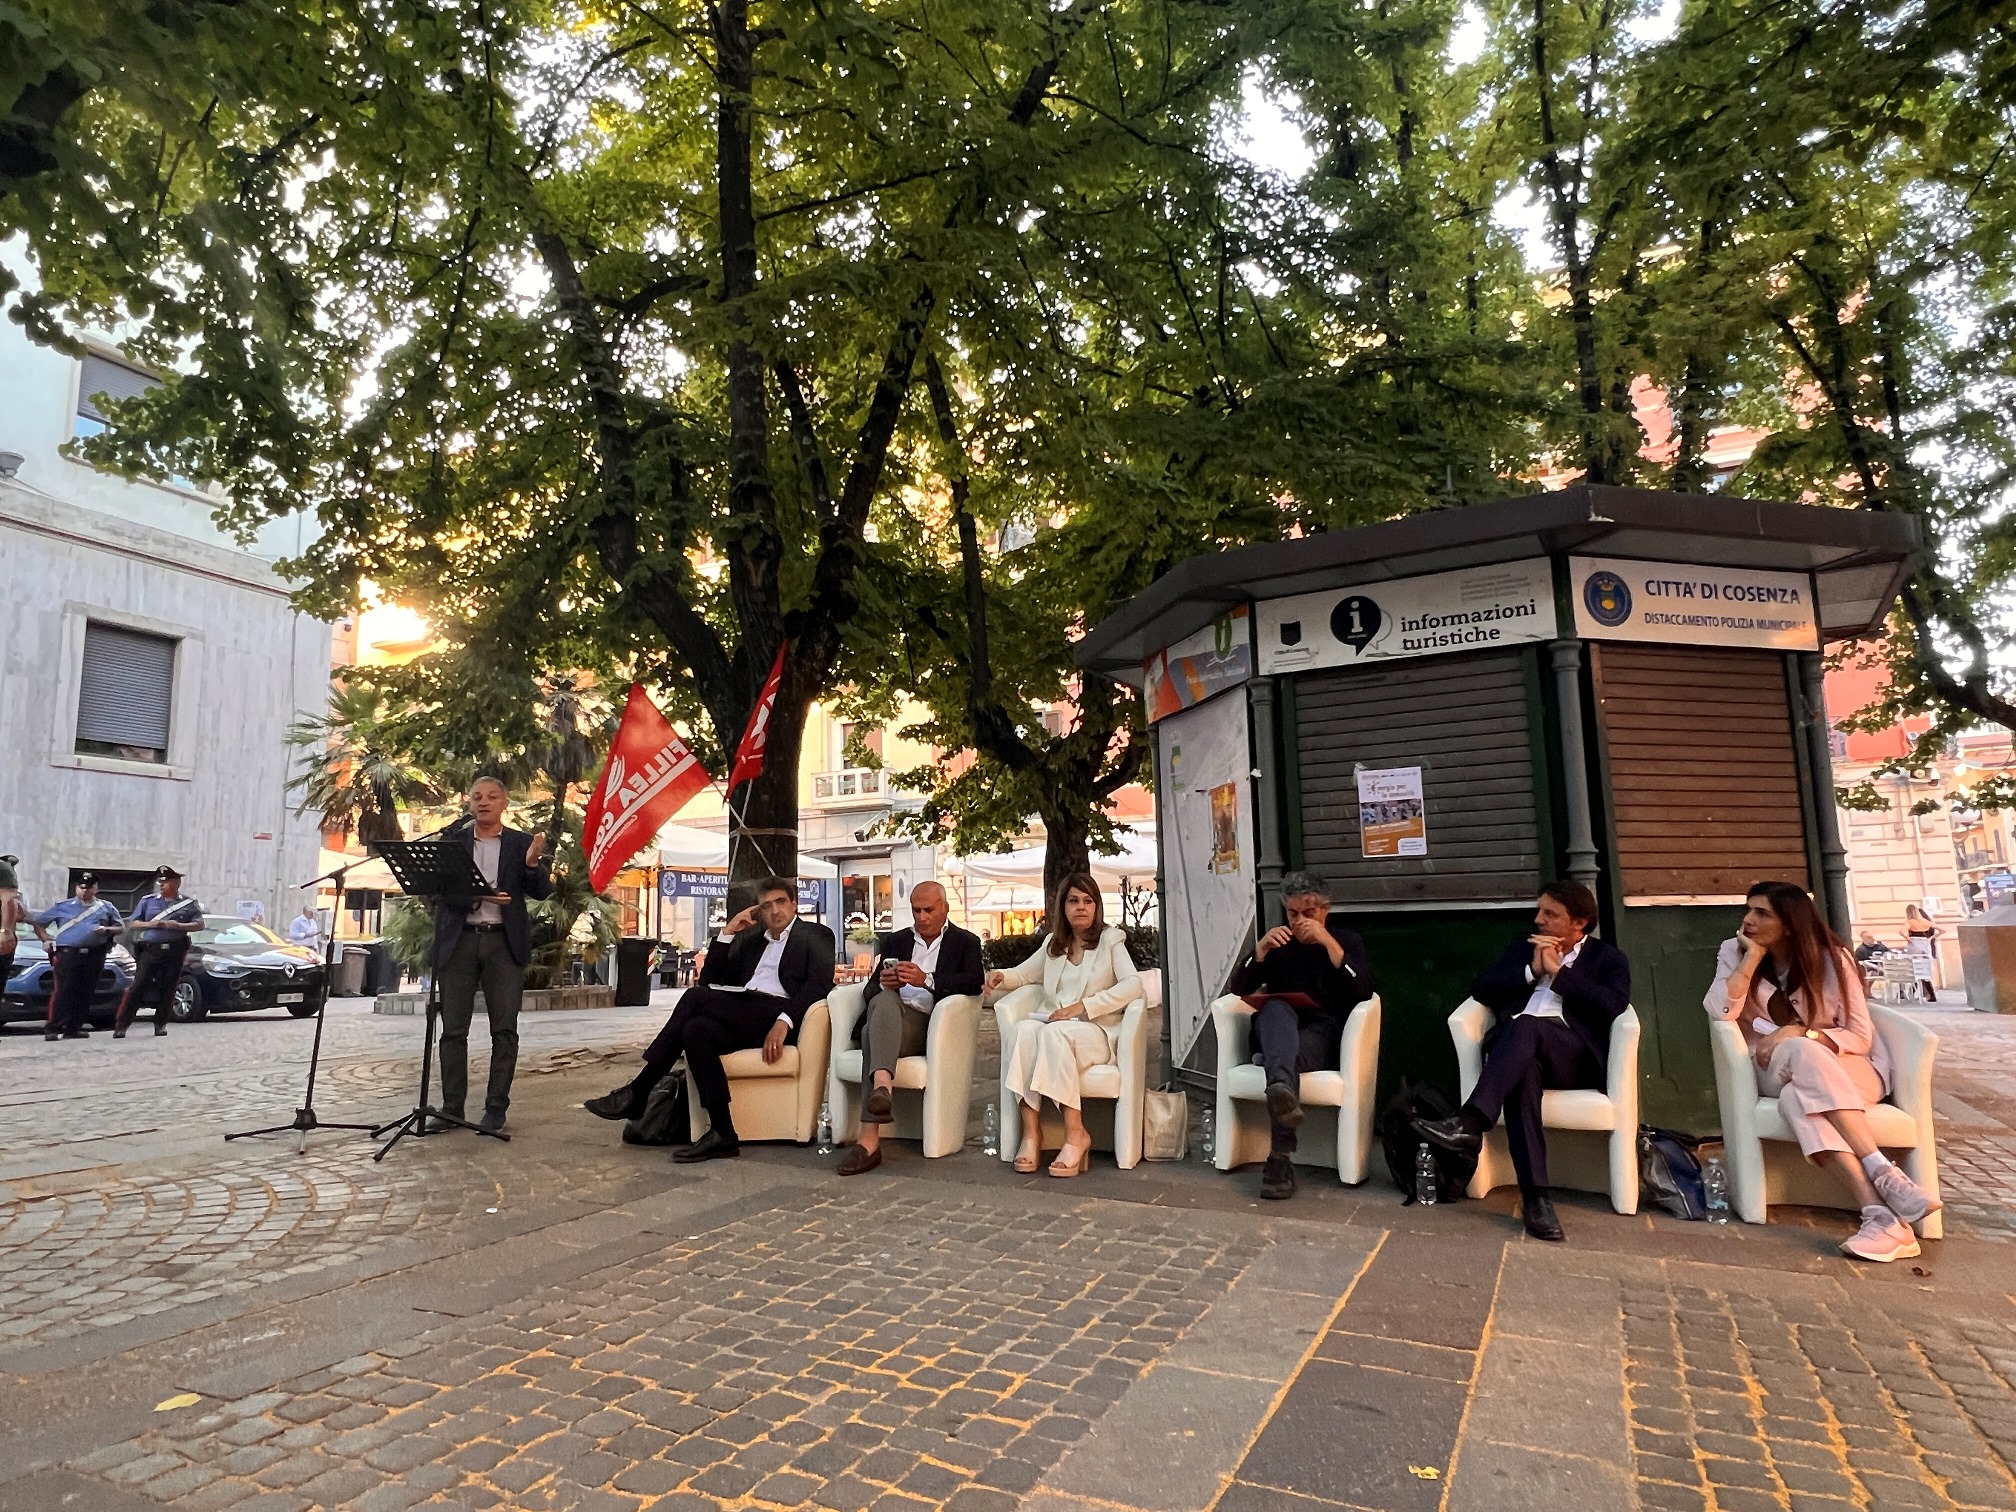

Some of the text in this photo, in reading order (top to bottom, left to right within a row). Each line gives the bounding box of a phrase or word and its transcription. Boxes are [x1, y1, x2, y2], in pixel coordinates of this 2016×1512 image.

[1700, 583, 1718, 601] DI
[1722, 585, 1802, 605] COSENZA
[1401, 599, 1537, 632] informazioni
[1644, 612, 1809, 632] DISTACCAMENTO POLIZIA MUNICIPALE
[1402, 626, 1501, 651] turistiche
[690, 885, 729, 896] RISTORAN
